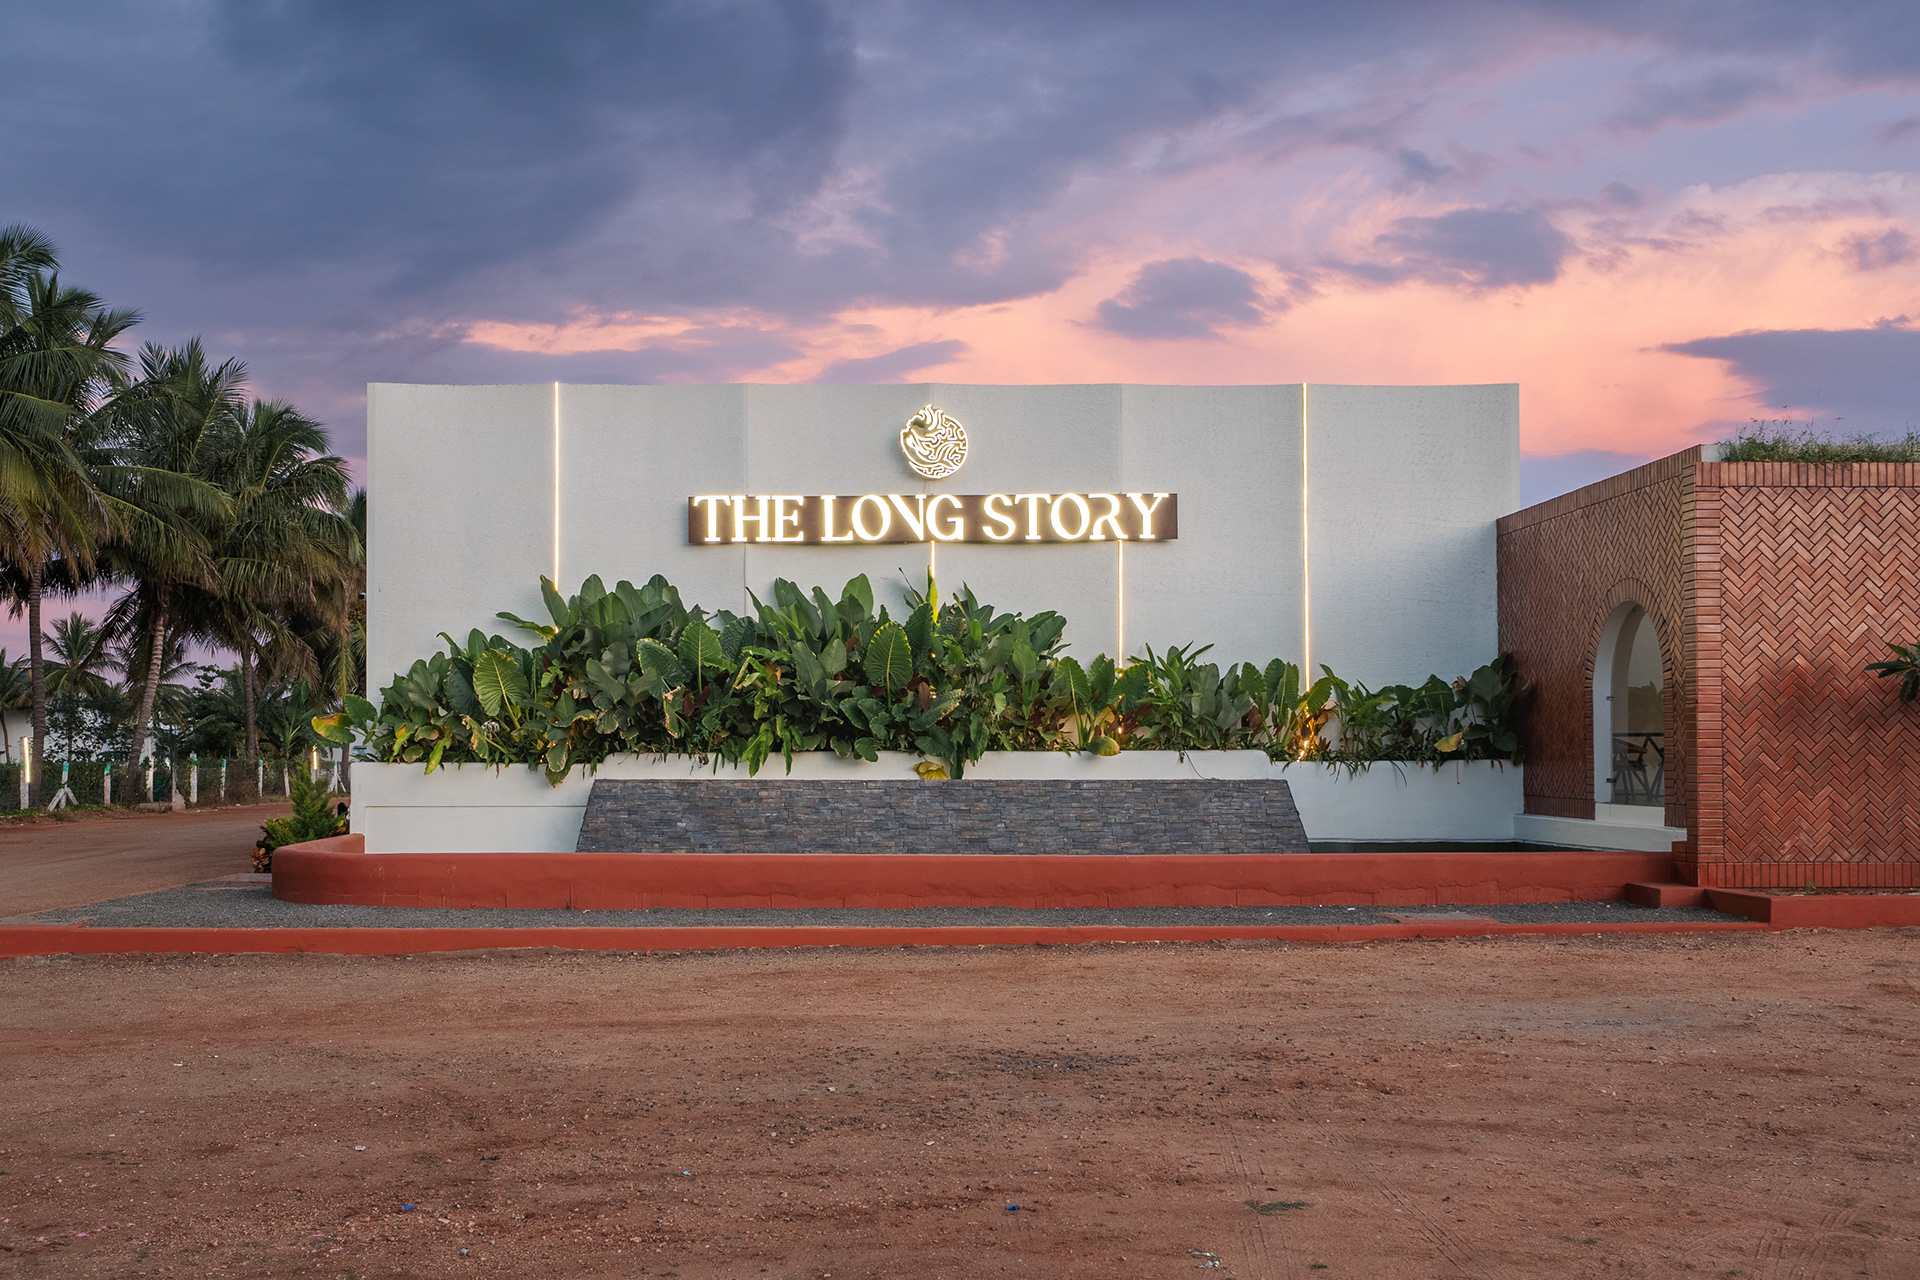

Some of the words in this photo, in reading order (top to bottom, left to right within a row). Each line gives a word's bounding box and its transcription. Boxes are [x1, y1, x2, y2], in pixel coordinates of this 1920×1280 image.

[694, 495, 804, 542] THE
[820, 494, 964, 541] LONG
[982, 493, 1169, 540] STORY
